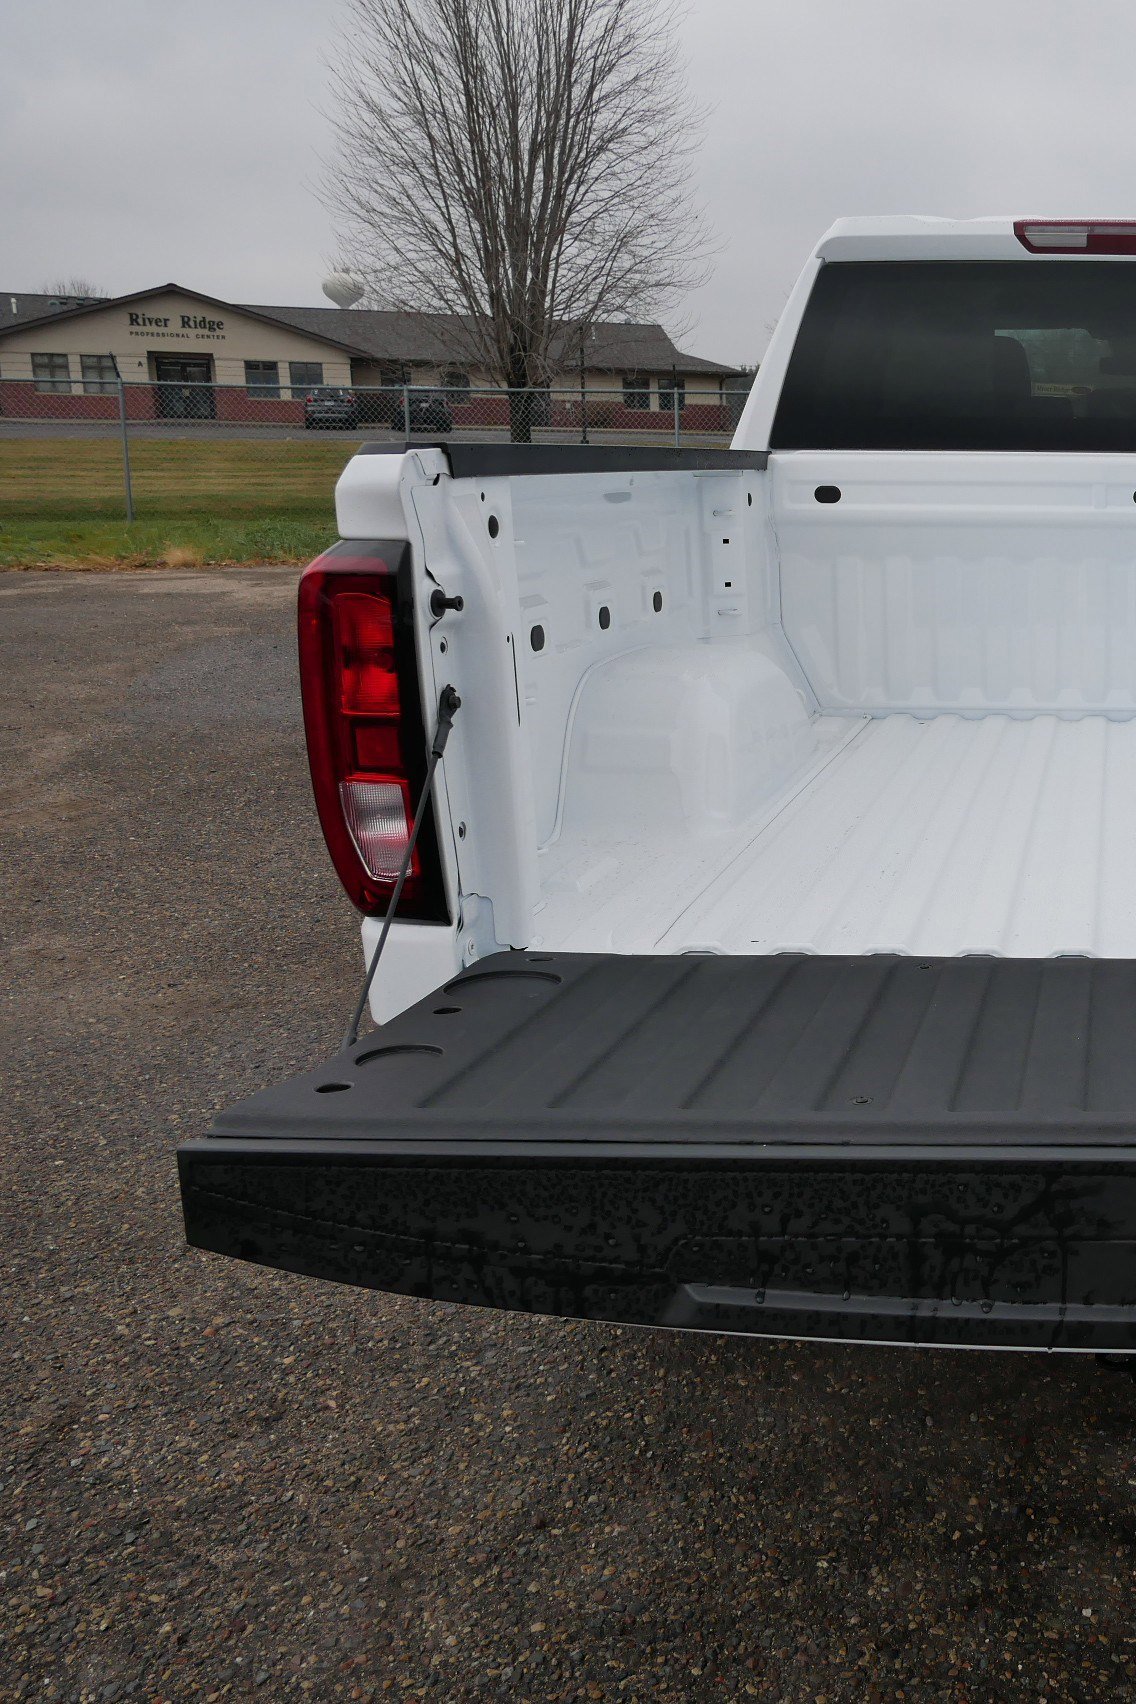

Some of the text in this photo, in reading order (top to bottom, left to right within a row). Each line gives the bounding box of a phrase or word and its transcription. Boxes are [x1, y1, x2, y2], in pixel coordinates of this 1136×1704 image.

[128, 312, 225, 332] River Ridge
[129, 331, 191, 339] PROFESSIONAL
